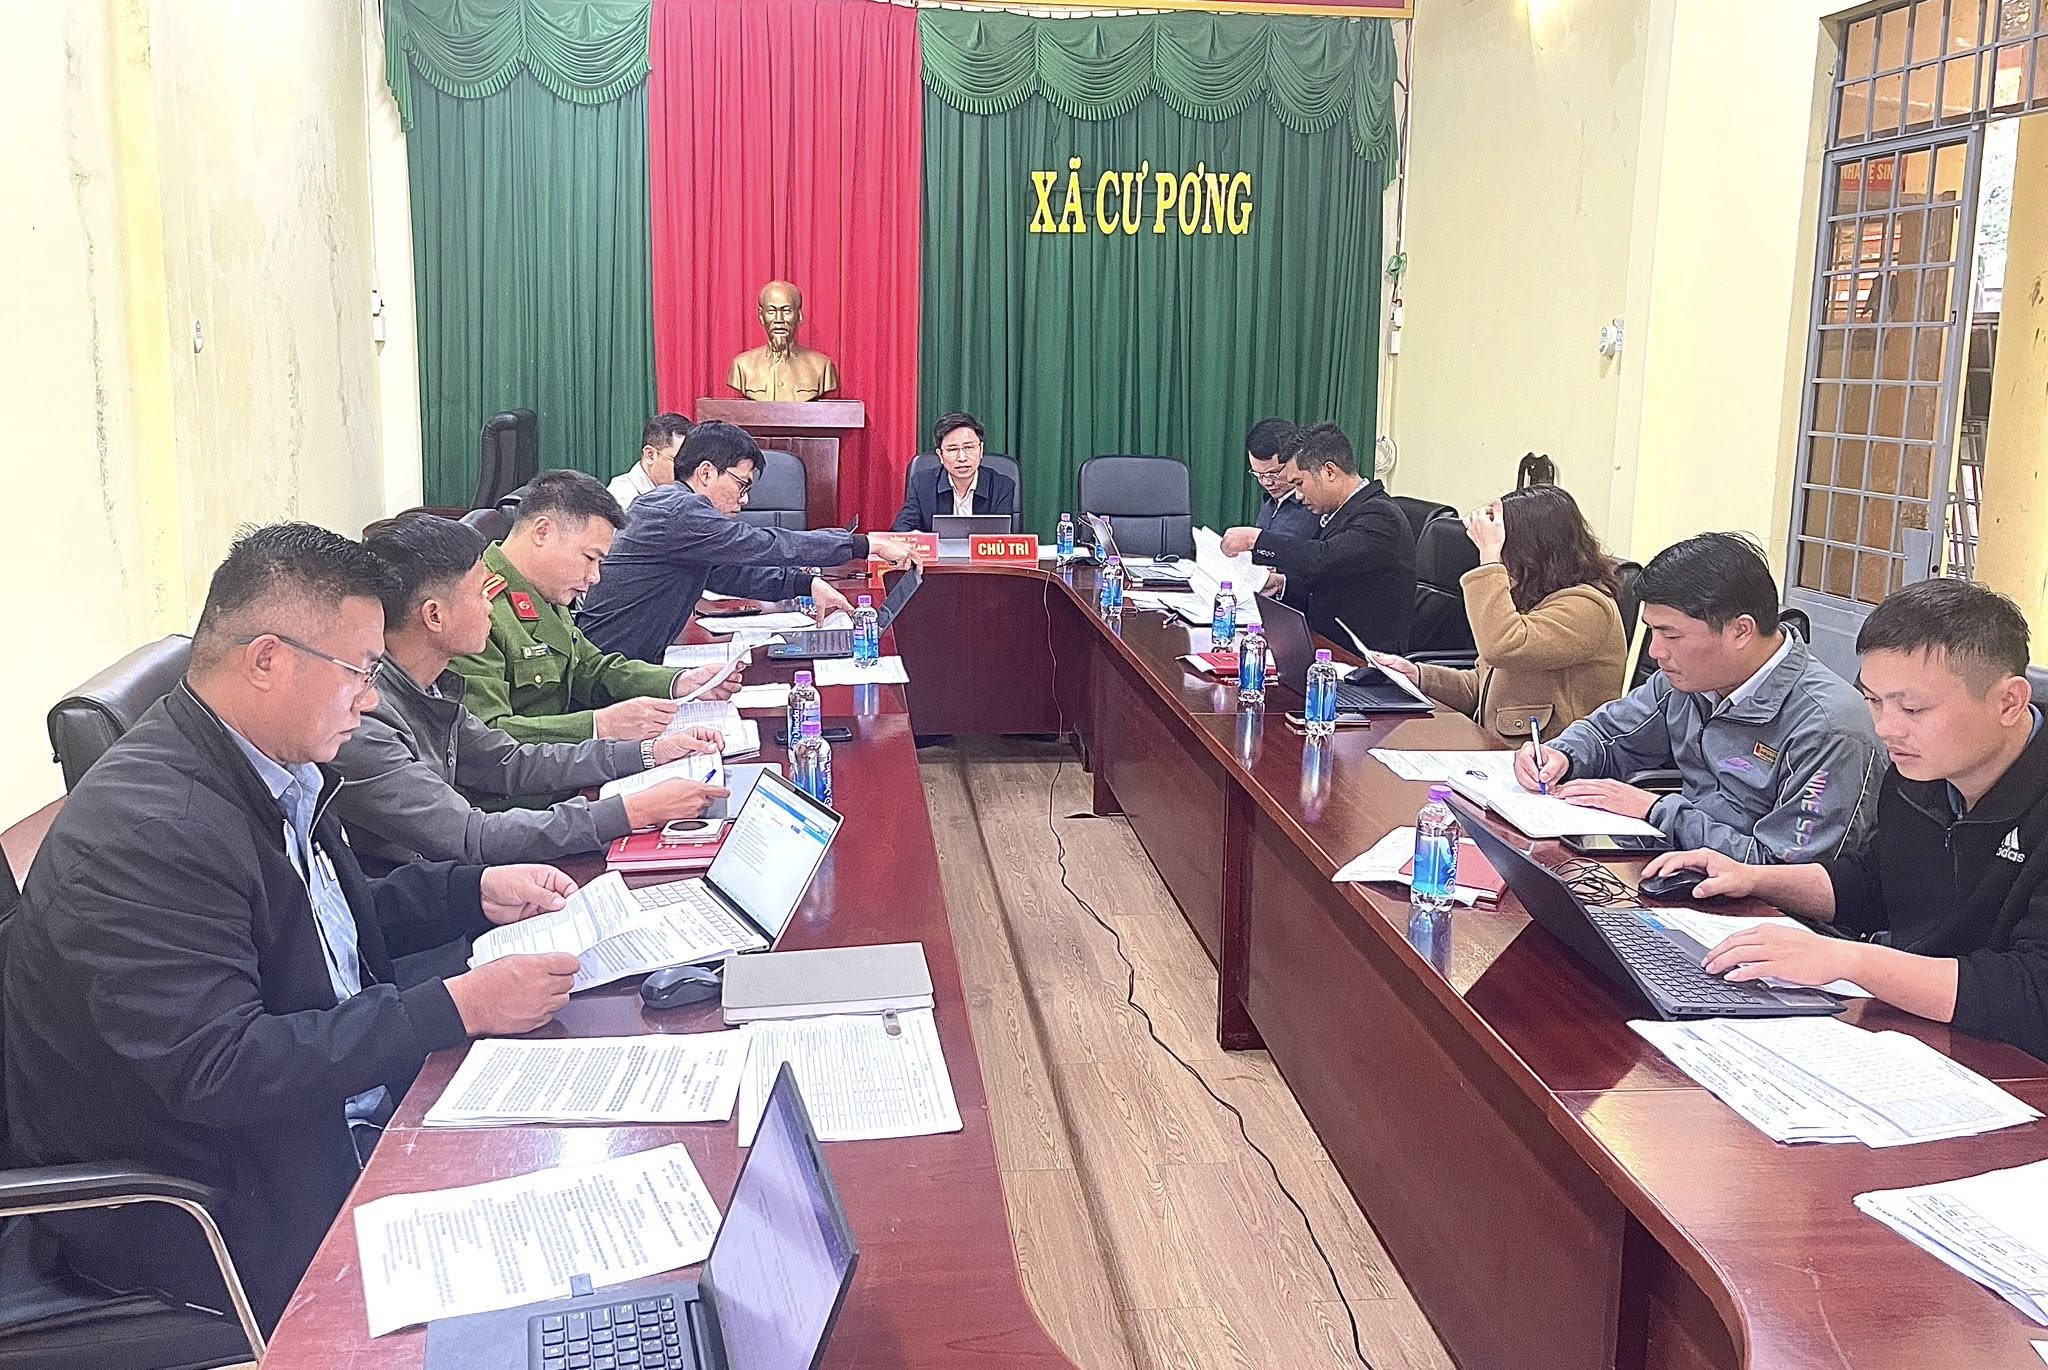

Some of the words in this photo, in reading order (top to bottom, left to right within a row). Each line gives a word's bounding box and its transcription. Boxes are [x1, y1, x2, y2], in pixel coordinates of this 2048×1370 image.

[1029, 156, 1088, 233] XÃ
[1096, 159, 1149, 235] CƯ
[1153, 161, 1253, 235] PƠNG
[977, 538, 1006, 556] CHỦ
[1008, 540, 1030, 556] TRÌ
[1800, 768, 1830, 814] NIKE
